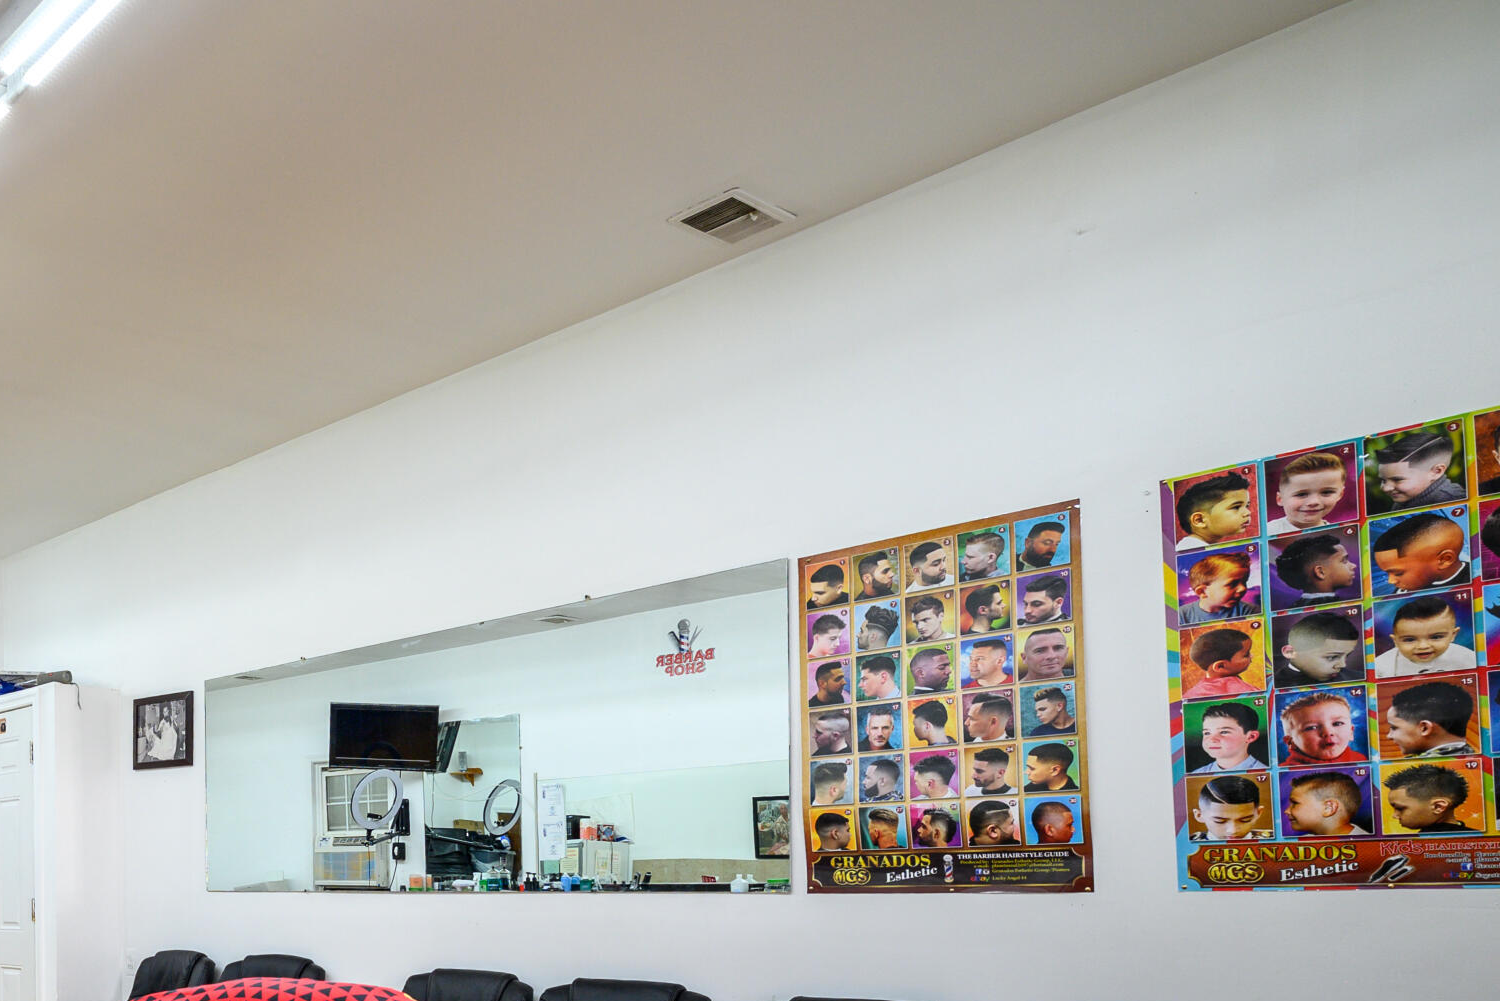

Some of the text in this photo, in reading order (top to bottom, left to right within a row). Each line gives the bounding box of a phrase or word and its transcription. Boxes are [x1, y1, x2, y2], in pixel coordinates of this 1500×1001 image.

[1203, 844, 1357, 864] GRANADOS
[1380, 840, 1424, 856] Kids
[830, 854, 931, 868] GRANADOS
[834, 869, 868, 884] MGS
[886, 866, 938, 883] Esthetic
[1211, 864, 1260, 882] MGS
[1280, 860, 1359, 882] Esthetic
